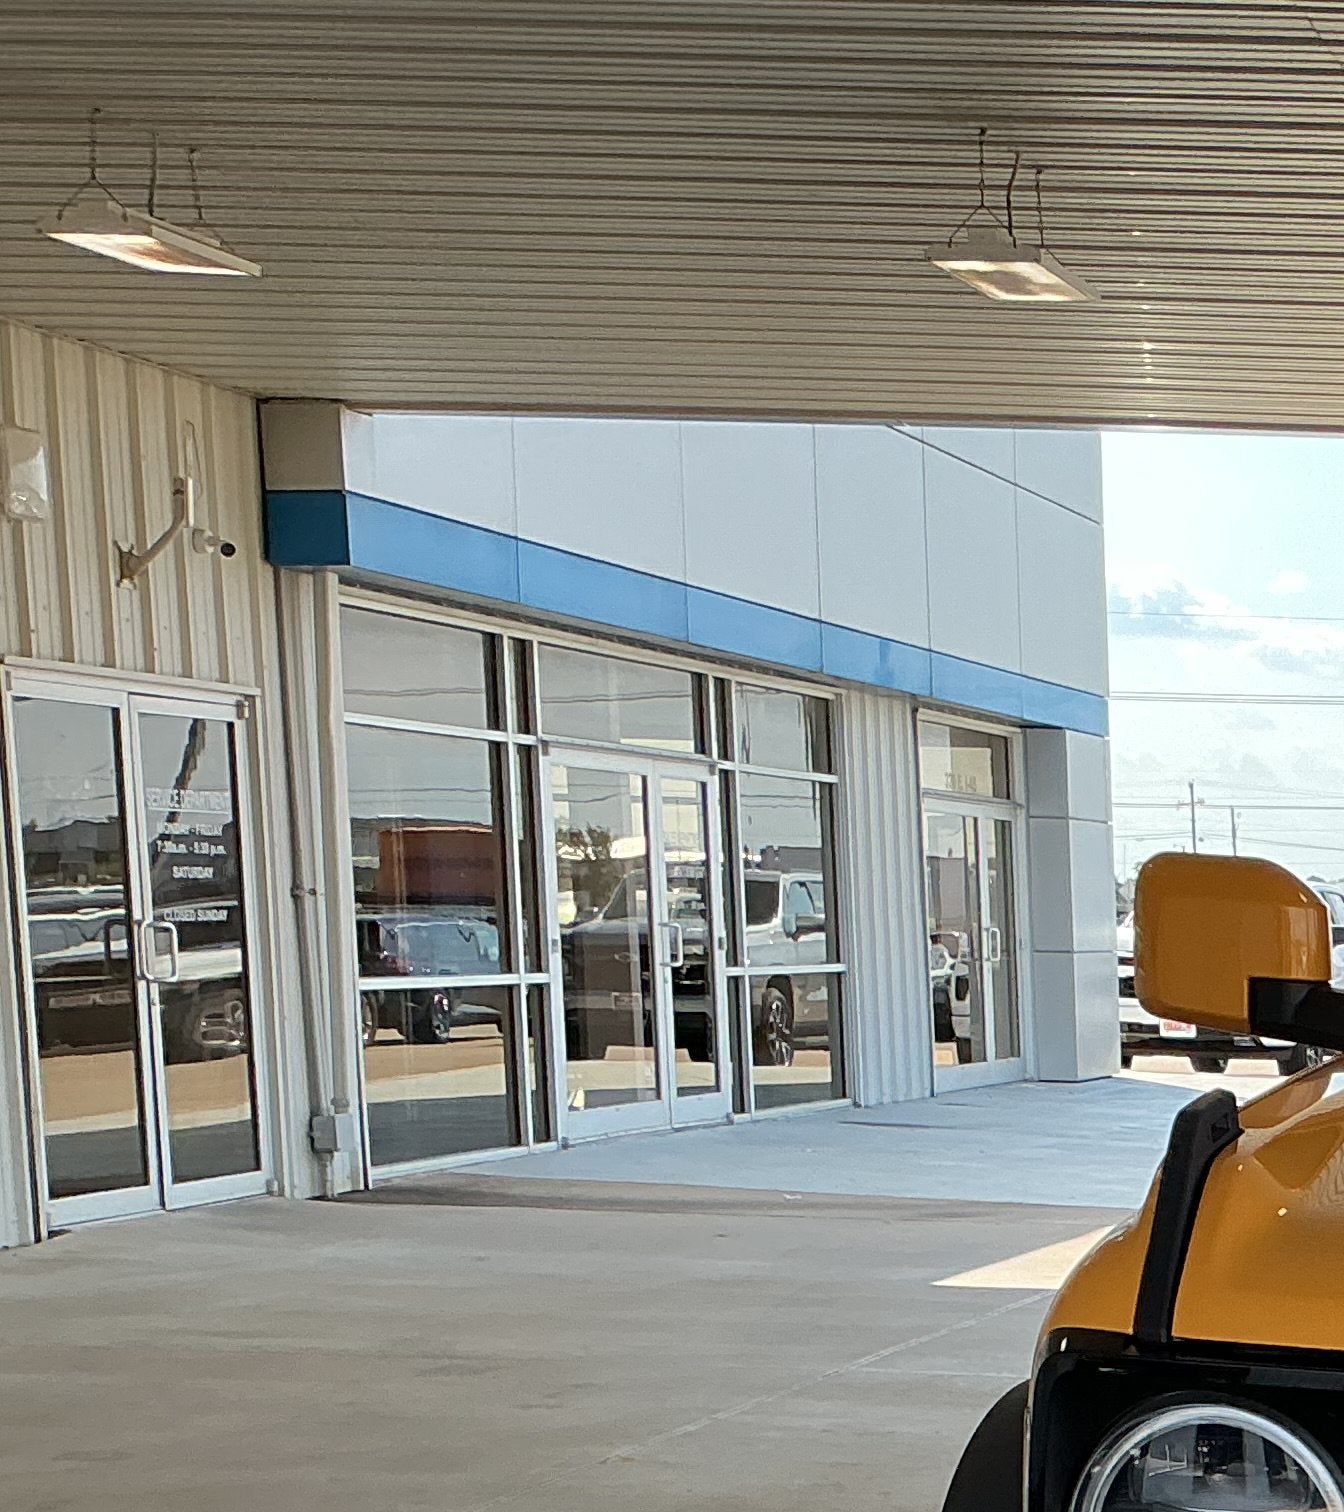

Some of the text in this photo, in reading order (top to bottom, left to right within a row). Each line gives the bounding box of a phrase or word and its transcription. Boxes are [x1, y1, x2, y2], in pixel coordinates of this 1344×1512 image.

[195, 823, 223, 837] FRIDAY
[172, 865, 214, 879] SATURDAY
[163, 909, 228, 922] CLOSED SUNDAY
